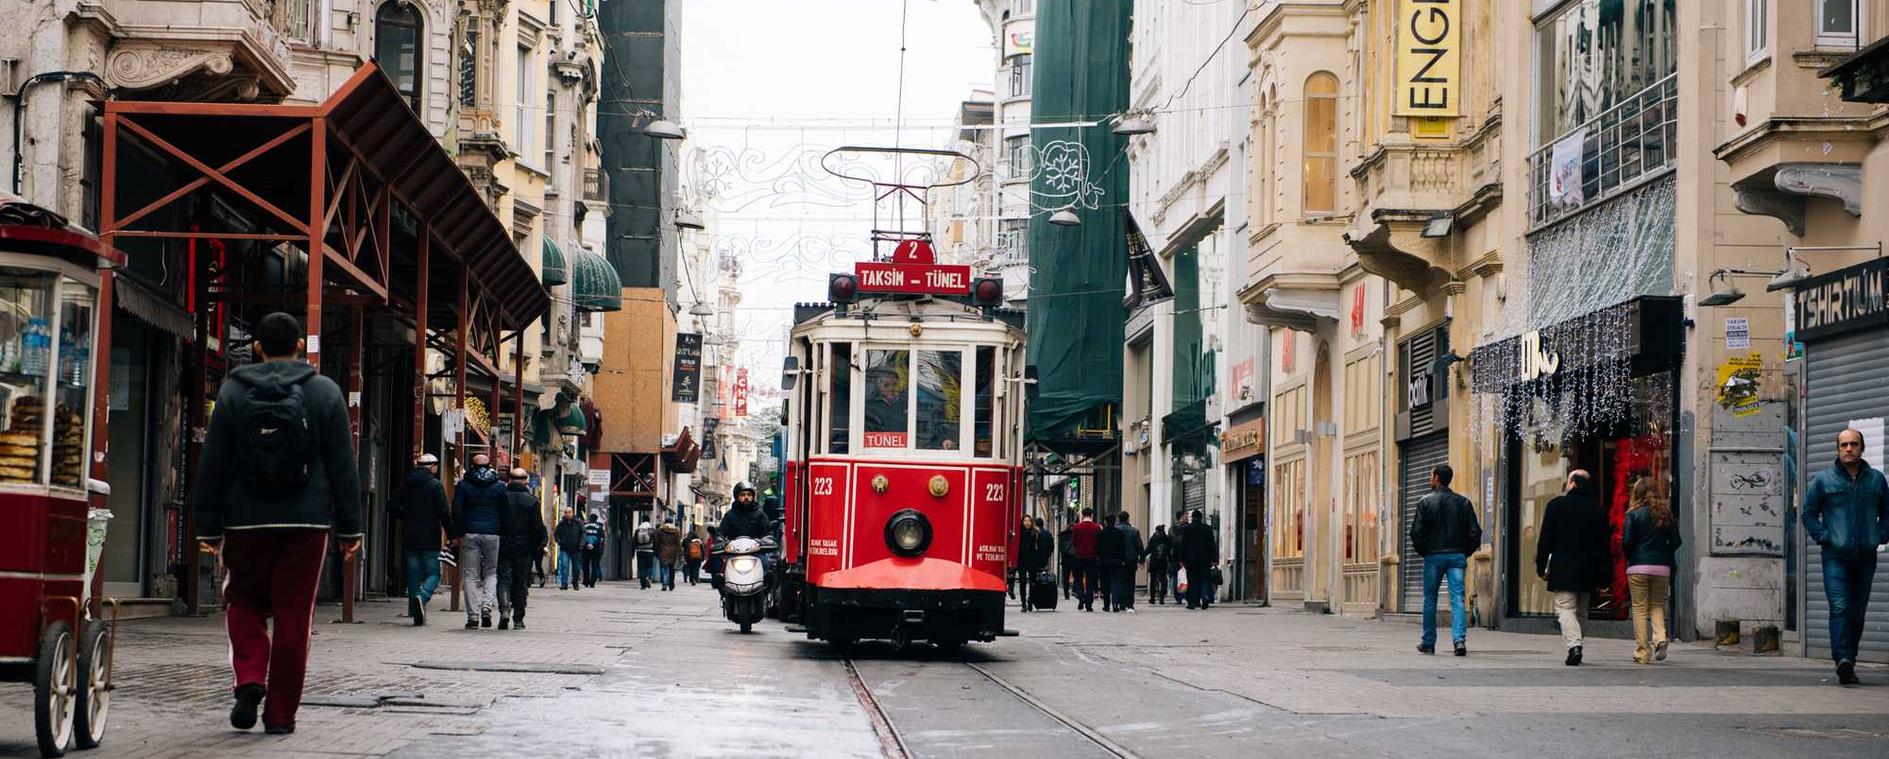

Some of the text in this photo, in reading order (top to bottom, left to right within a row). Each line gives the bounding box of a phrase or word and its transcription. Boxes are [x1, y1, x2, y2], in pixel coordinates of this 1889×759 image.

[1409, 0, 1449, 108] ENG
[909, 241, 918, 259] 2
[926, 269, 966, 288] TÜNEL
[867, 433, 906, 447] TÜNEL
[814, 477, 833, 496] 223
[986, 483, 1004, 502] 223
